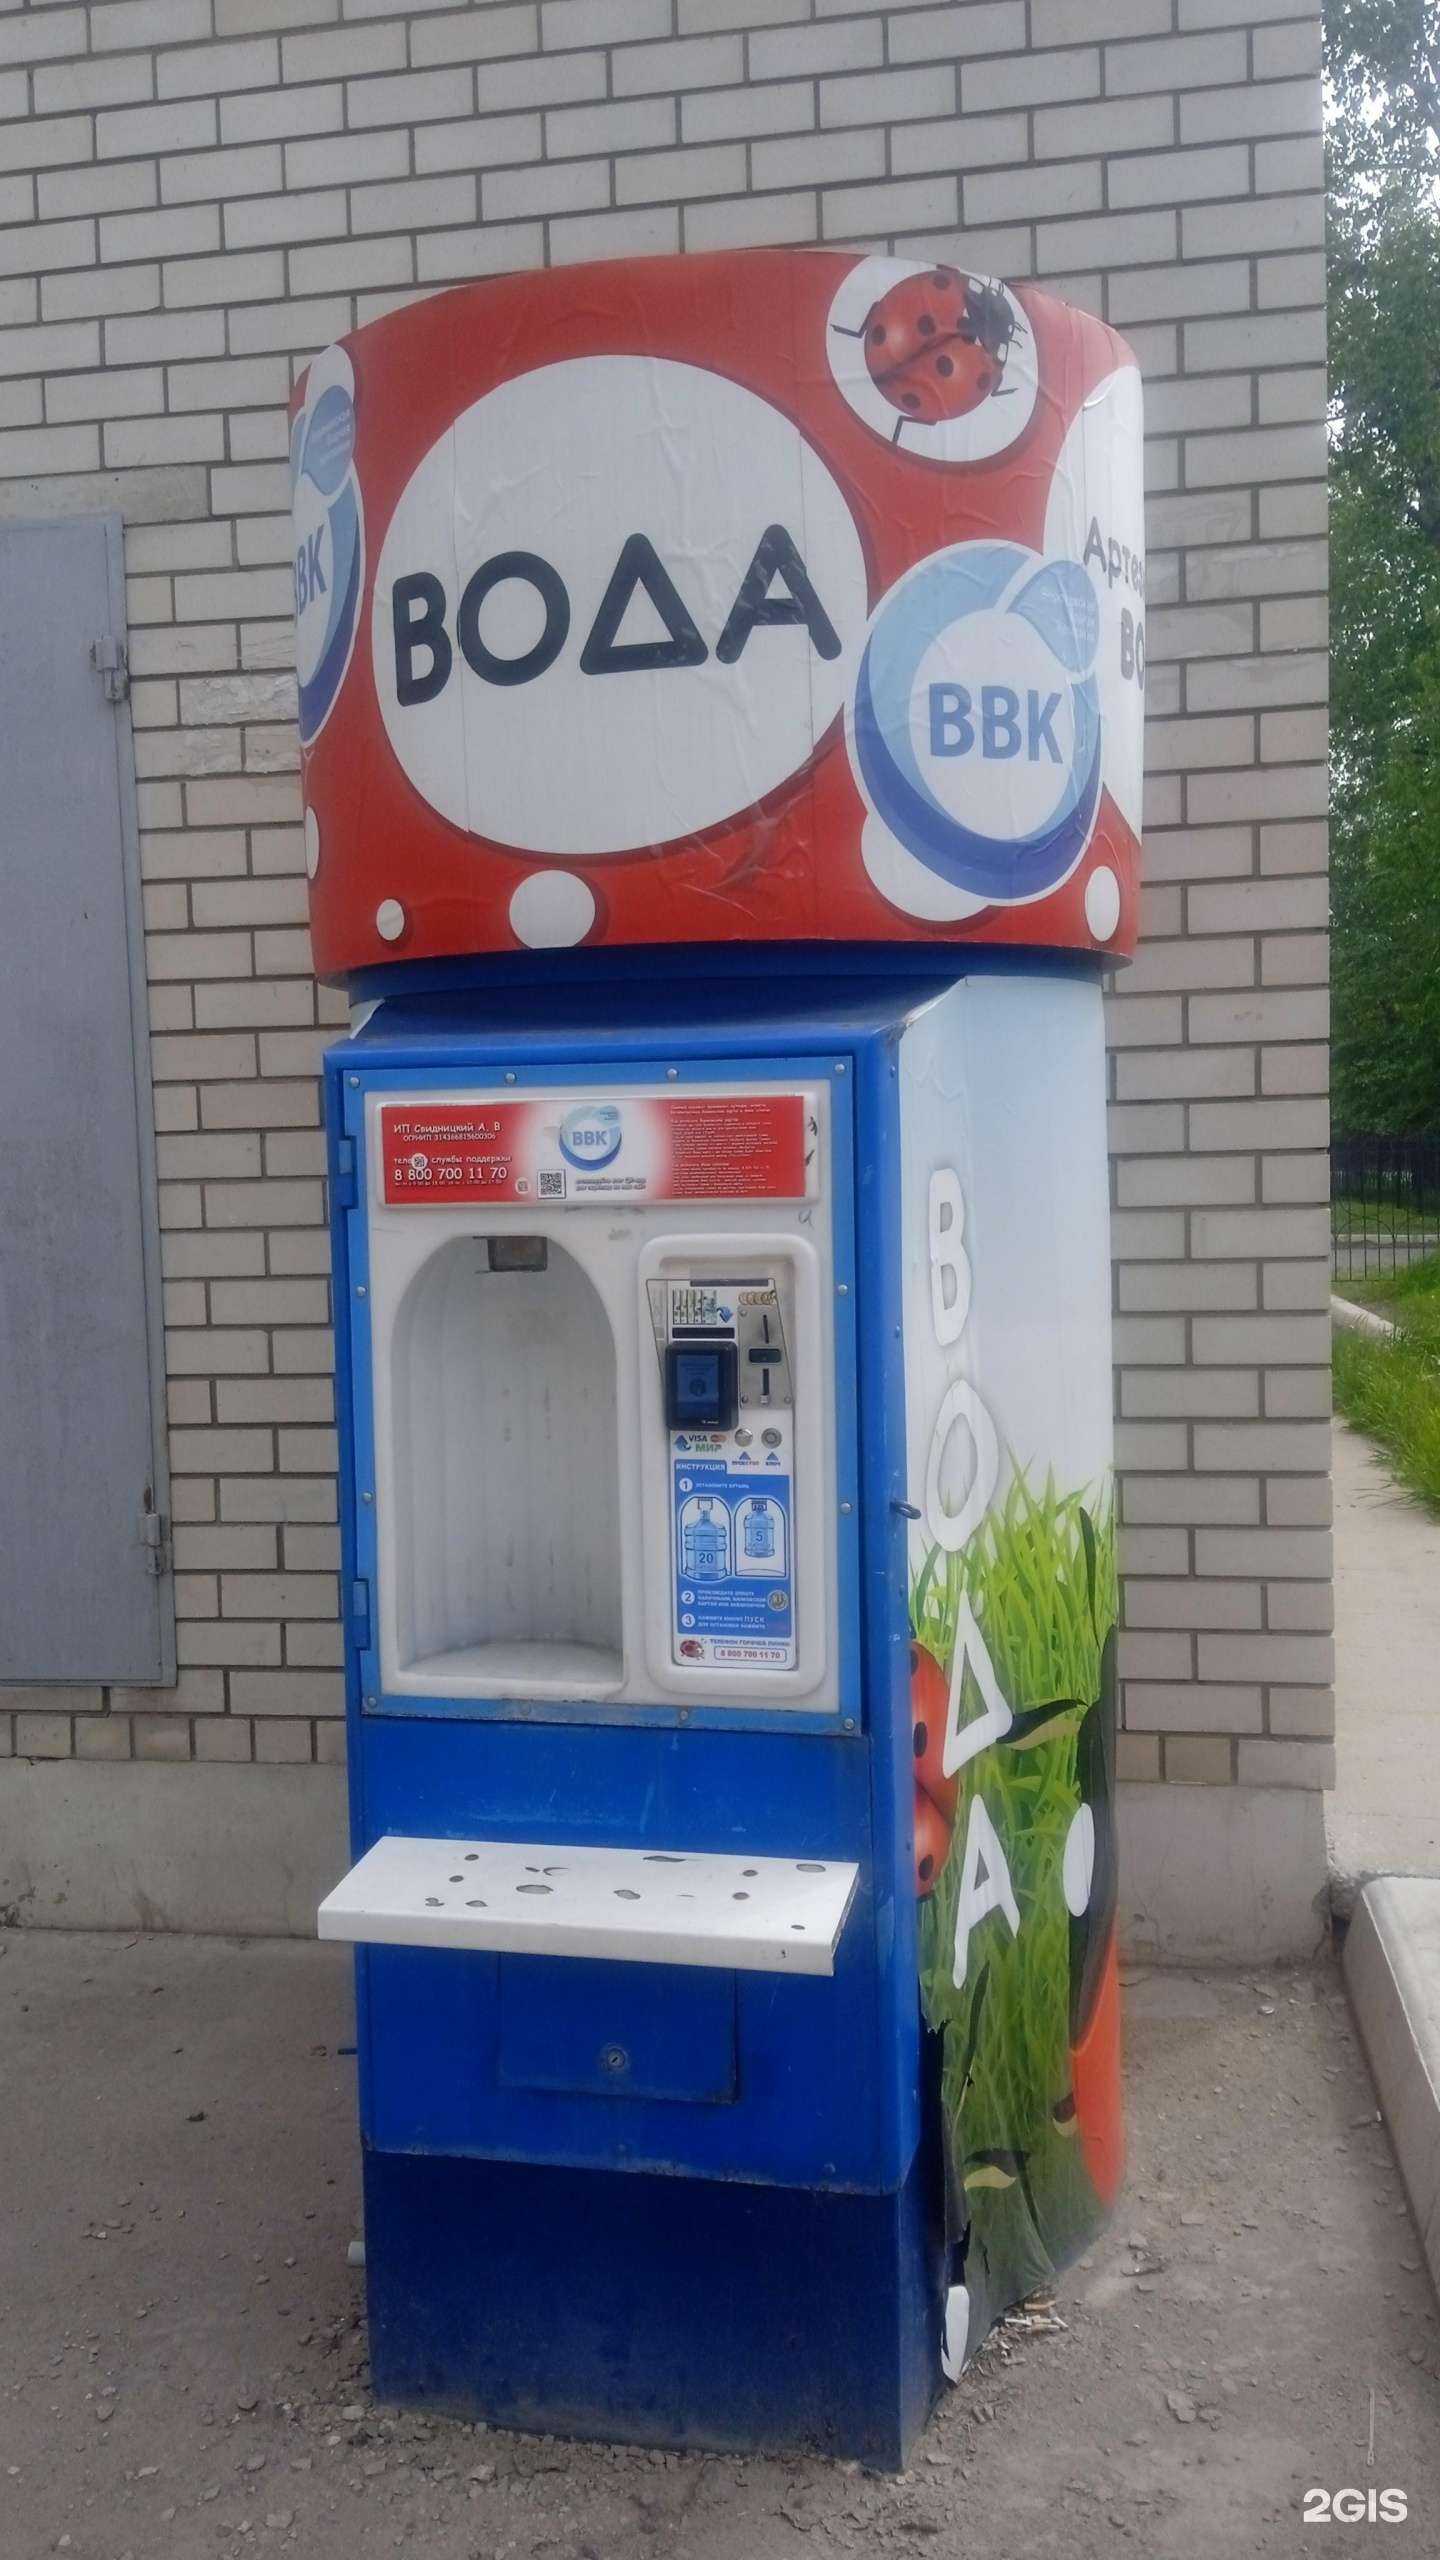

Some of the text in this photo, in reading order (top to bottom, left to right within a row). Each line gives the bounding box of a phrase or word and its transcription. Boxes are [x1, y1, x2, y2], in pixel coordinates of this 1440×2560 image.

[392, 524, 843, 707] ВОДА
[394, 1123, 410, 1134] ИП
[394, 1166, 507, 1181] 8 800 700 11 70
[689, 1434, 708, 1443] VISA
[676, 1463, 726, 1472] ИНСТРУКЦИЯ
[756, 1531, 763, 1542] 5
[699, 1553, 714, 1564] 20
[743, 1650, 757, 1658] 700
[759, 1651, 769, 1659] 11
